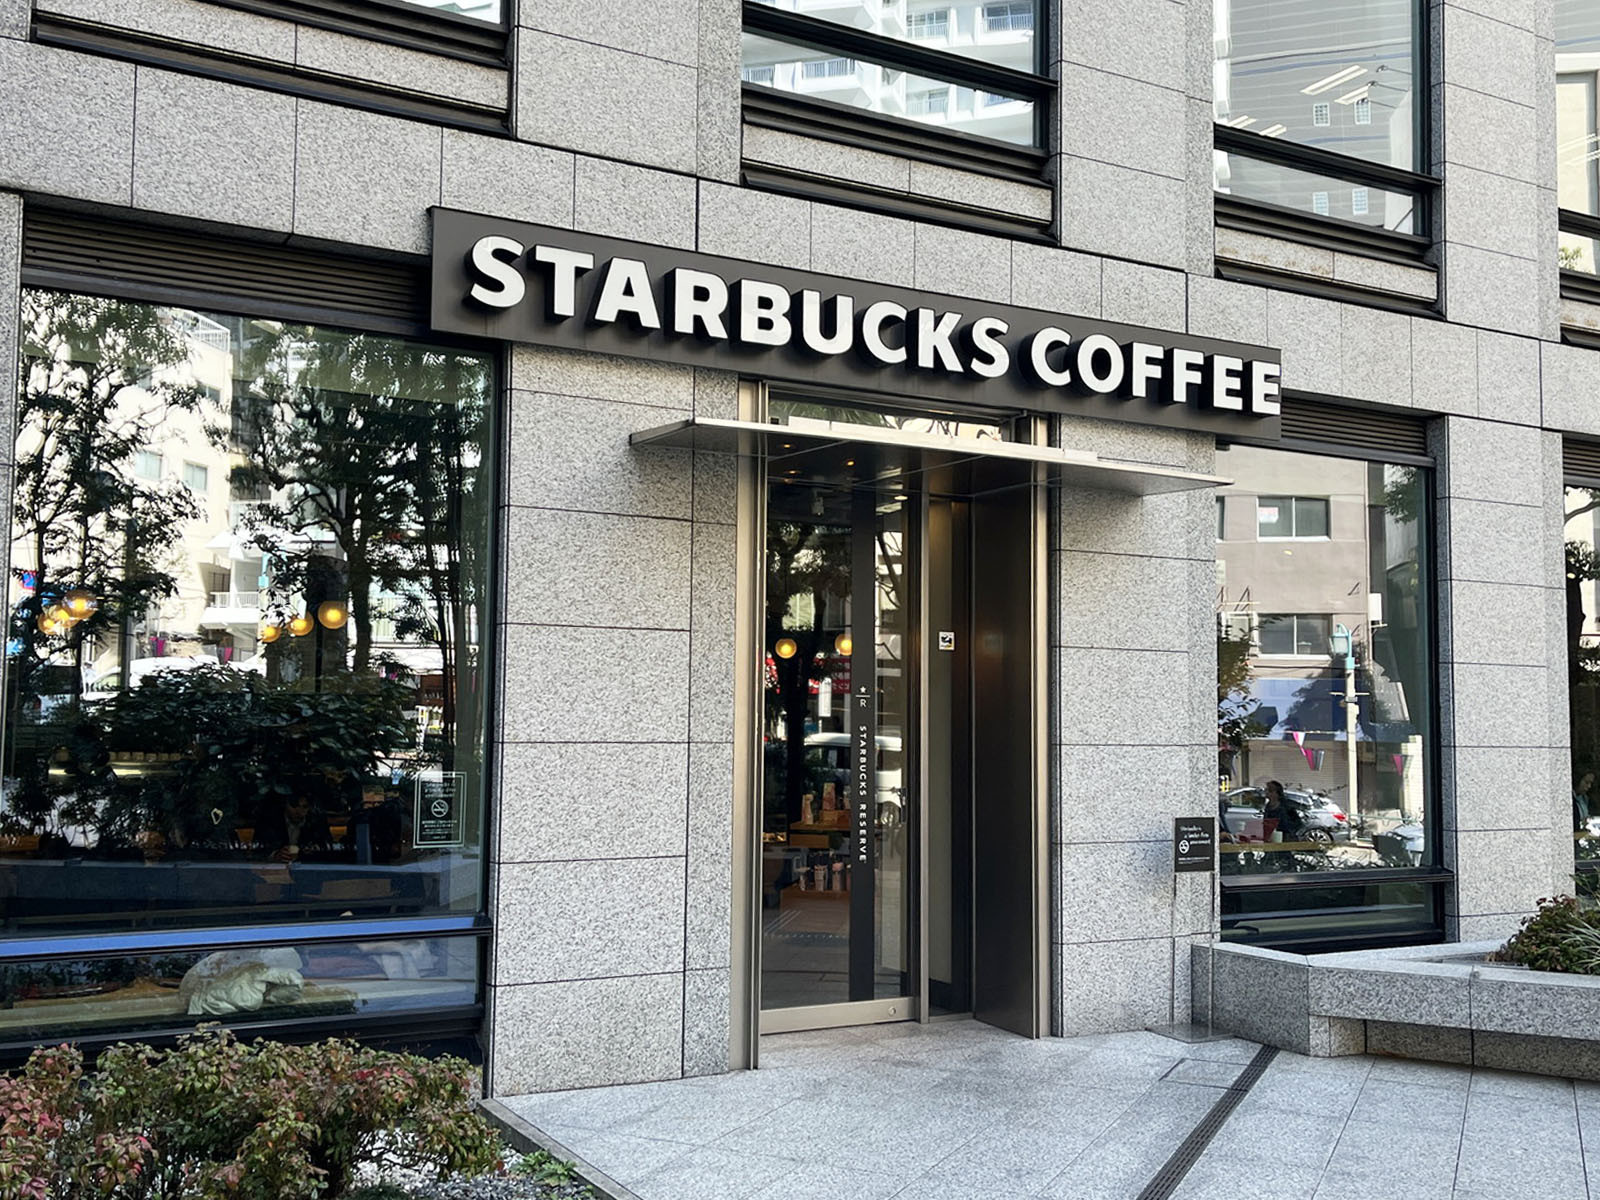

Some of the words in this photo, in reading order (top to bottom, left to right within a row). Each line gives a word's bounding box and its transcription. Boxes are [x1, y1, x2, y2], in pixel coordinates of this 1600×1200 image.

[471, 236, 1010, 378] STARBUCKS
[1031, 327, 1281, 415] COFFEE
[860, 699, 867, 708] R
[859, 725, 867, 796] STARBUCKS
[859, 803, 867, 861] RESERVE
